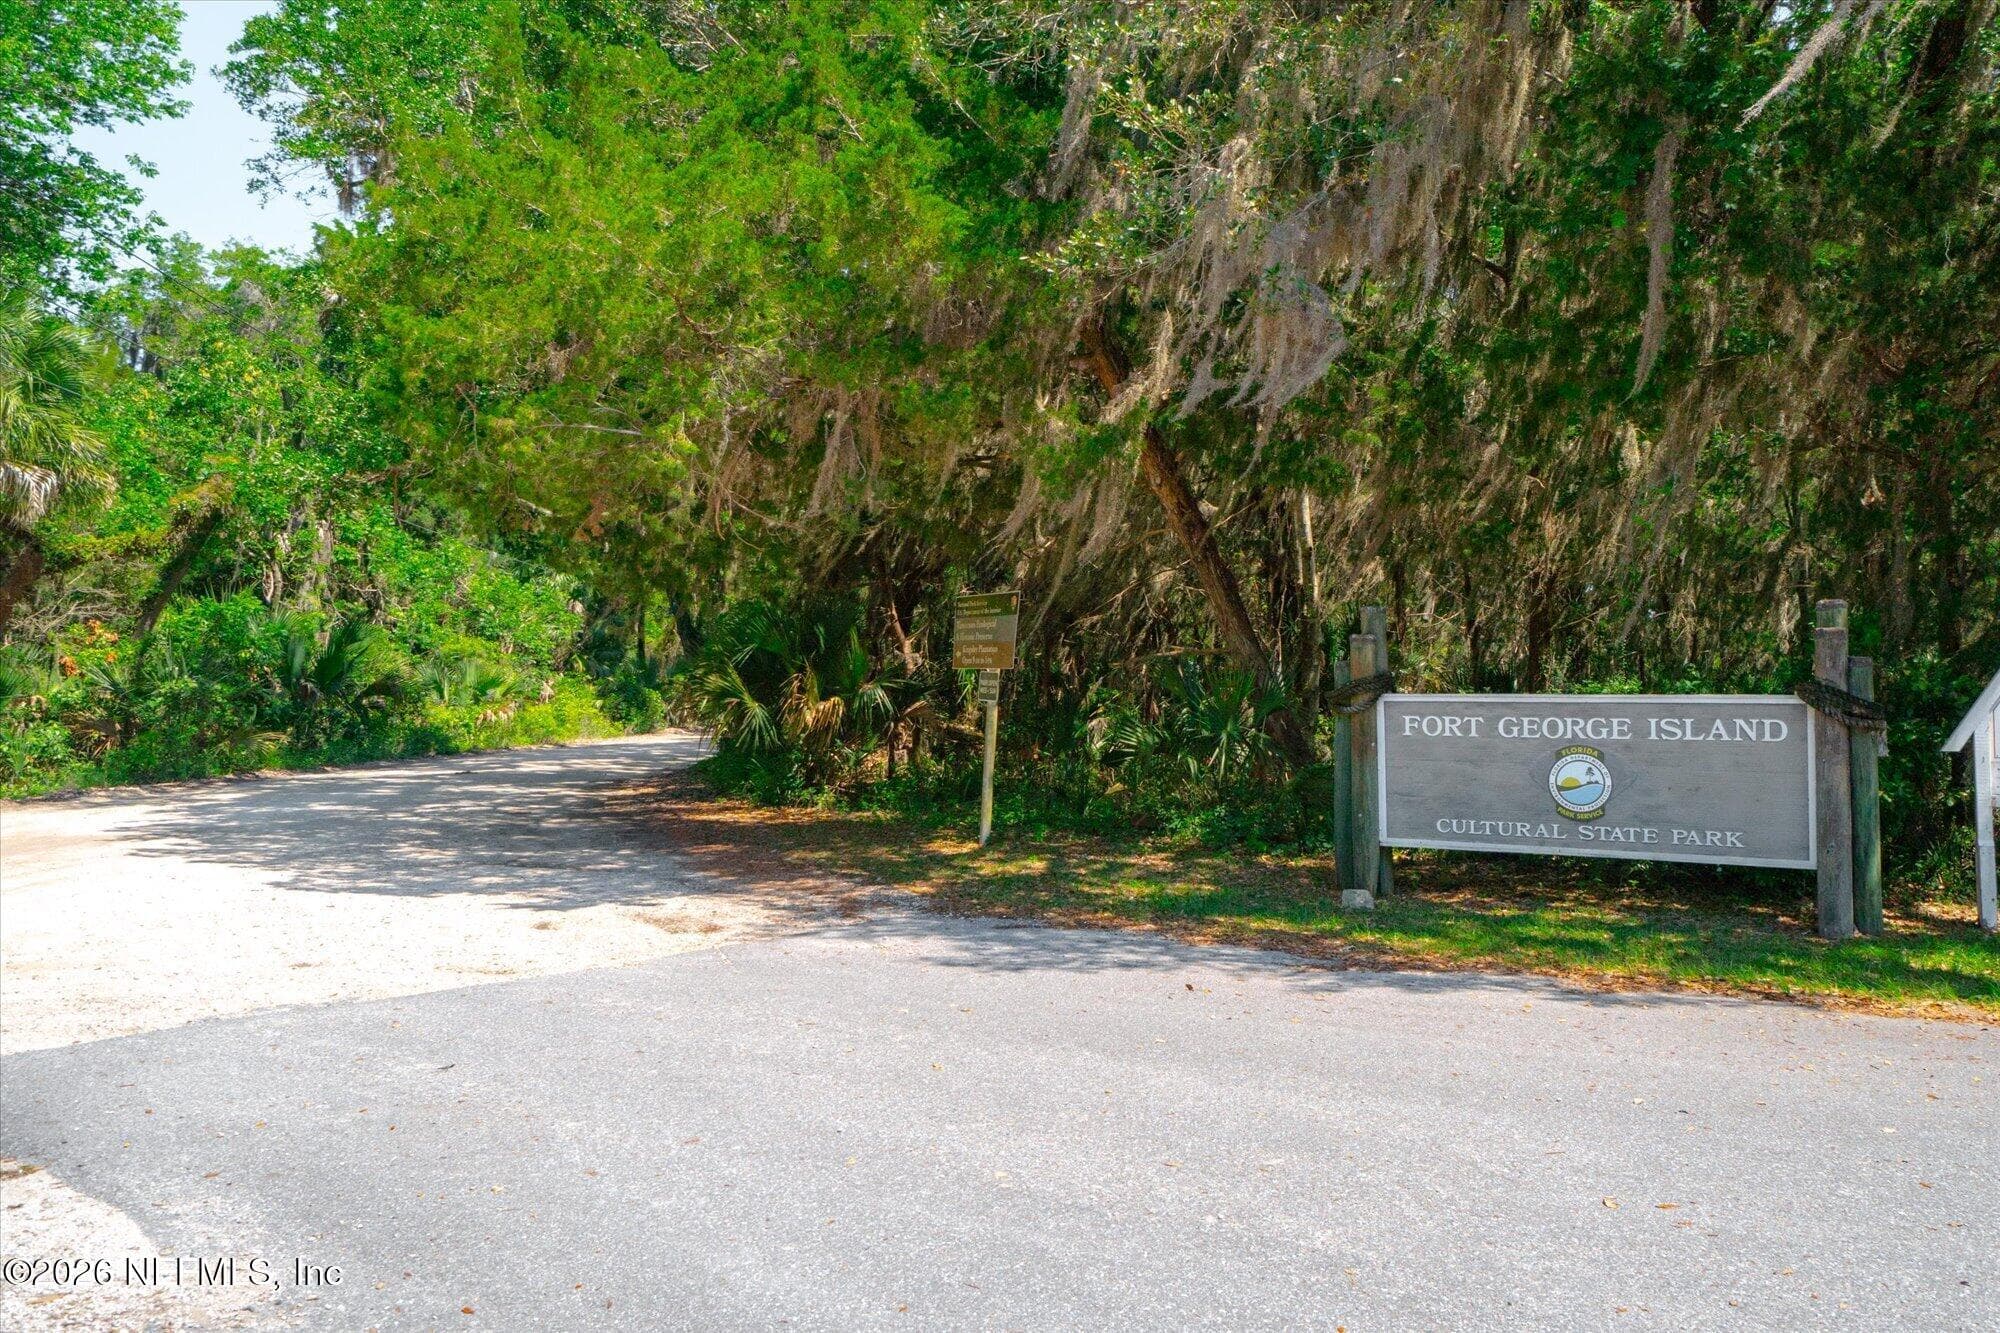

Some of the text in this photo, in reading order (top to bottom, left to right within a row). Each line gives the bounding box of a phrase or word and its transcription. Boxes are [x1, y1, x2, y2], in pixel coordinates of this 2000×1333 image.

[1402, 715, 1788, 743] FORT GEORGE ISLAND
[1561, 746, 1599, 757] FLORIDA
[1557, 806, 1604, 820] PARK SERVICE
[1436, 818, 1744, 848] CULTURAL STATE PARK
